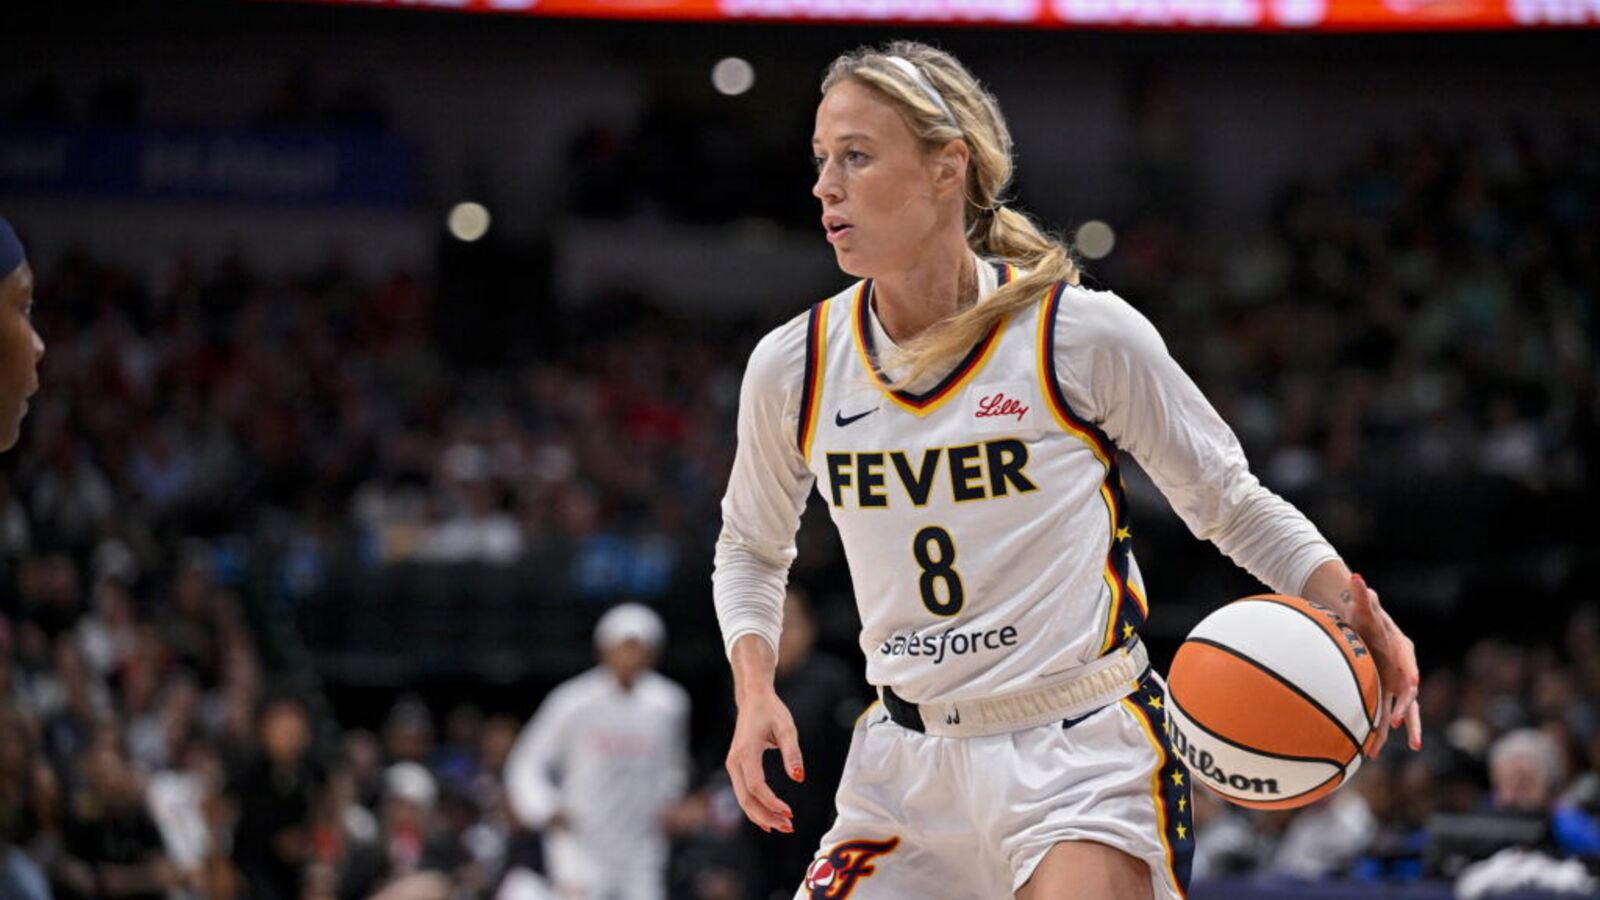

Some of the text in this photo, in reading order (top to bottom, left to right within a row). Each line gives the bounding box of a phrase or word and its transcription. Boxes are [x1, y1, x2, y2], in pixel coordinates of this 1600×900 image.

[974, 393, 1030, 422] Lilly
[826, 437, 1041, 509] FEVER
[912, 525, 965, 618] 8
[880, 625, 1018, 664] saesforce
[1168, 710, 1281, 794] Wilson
